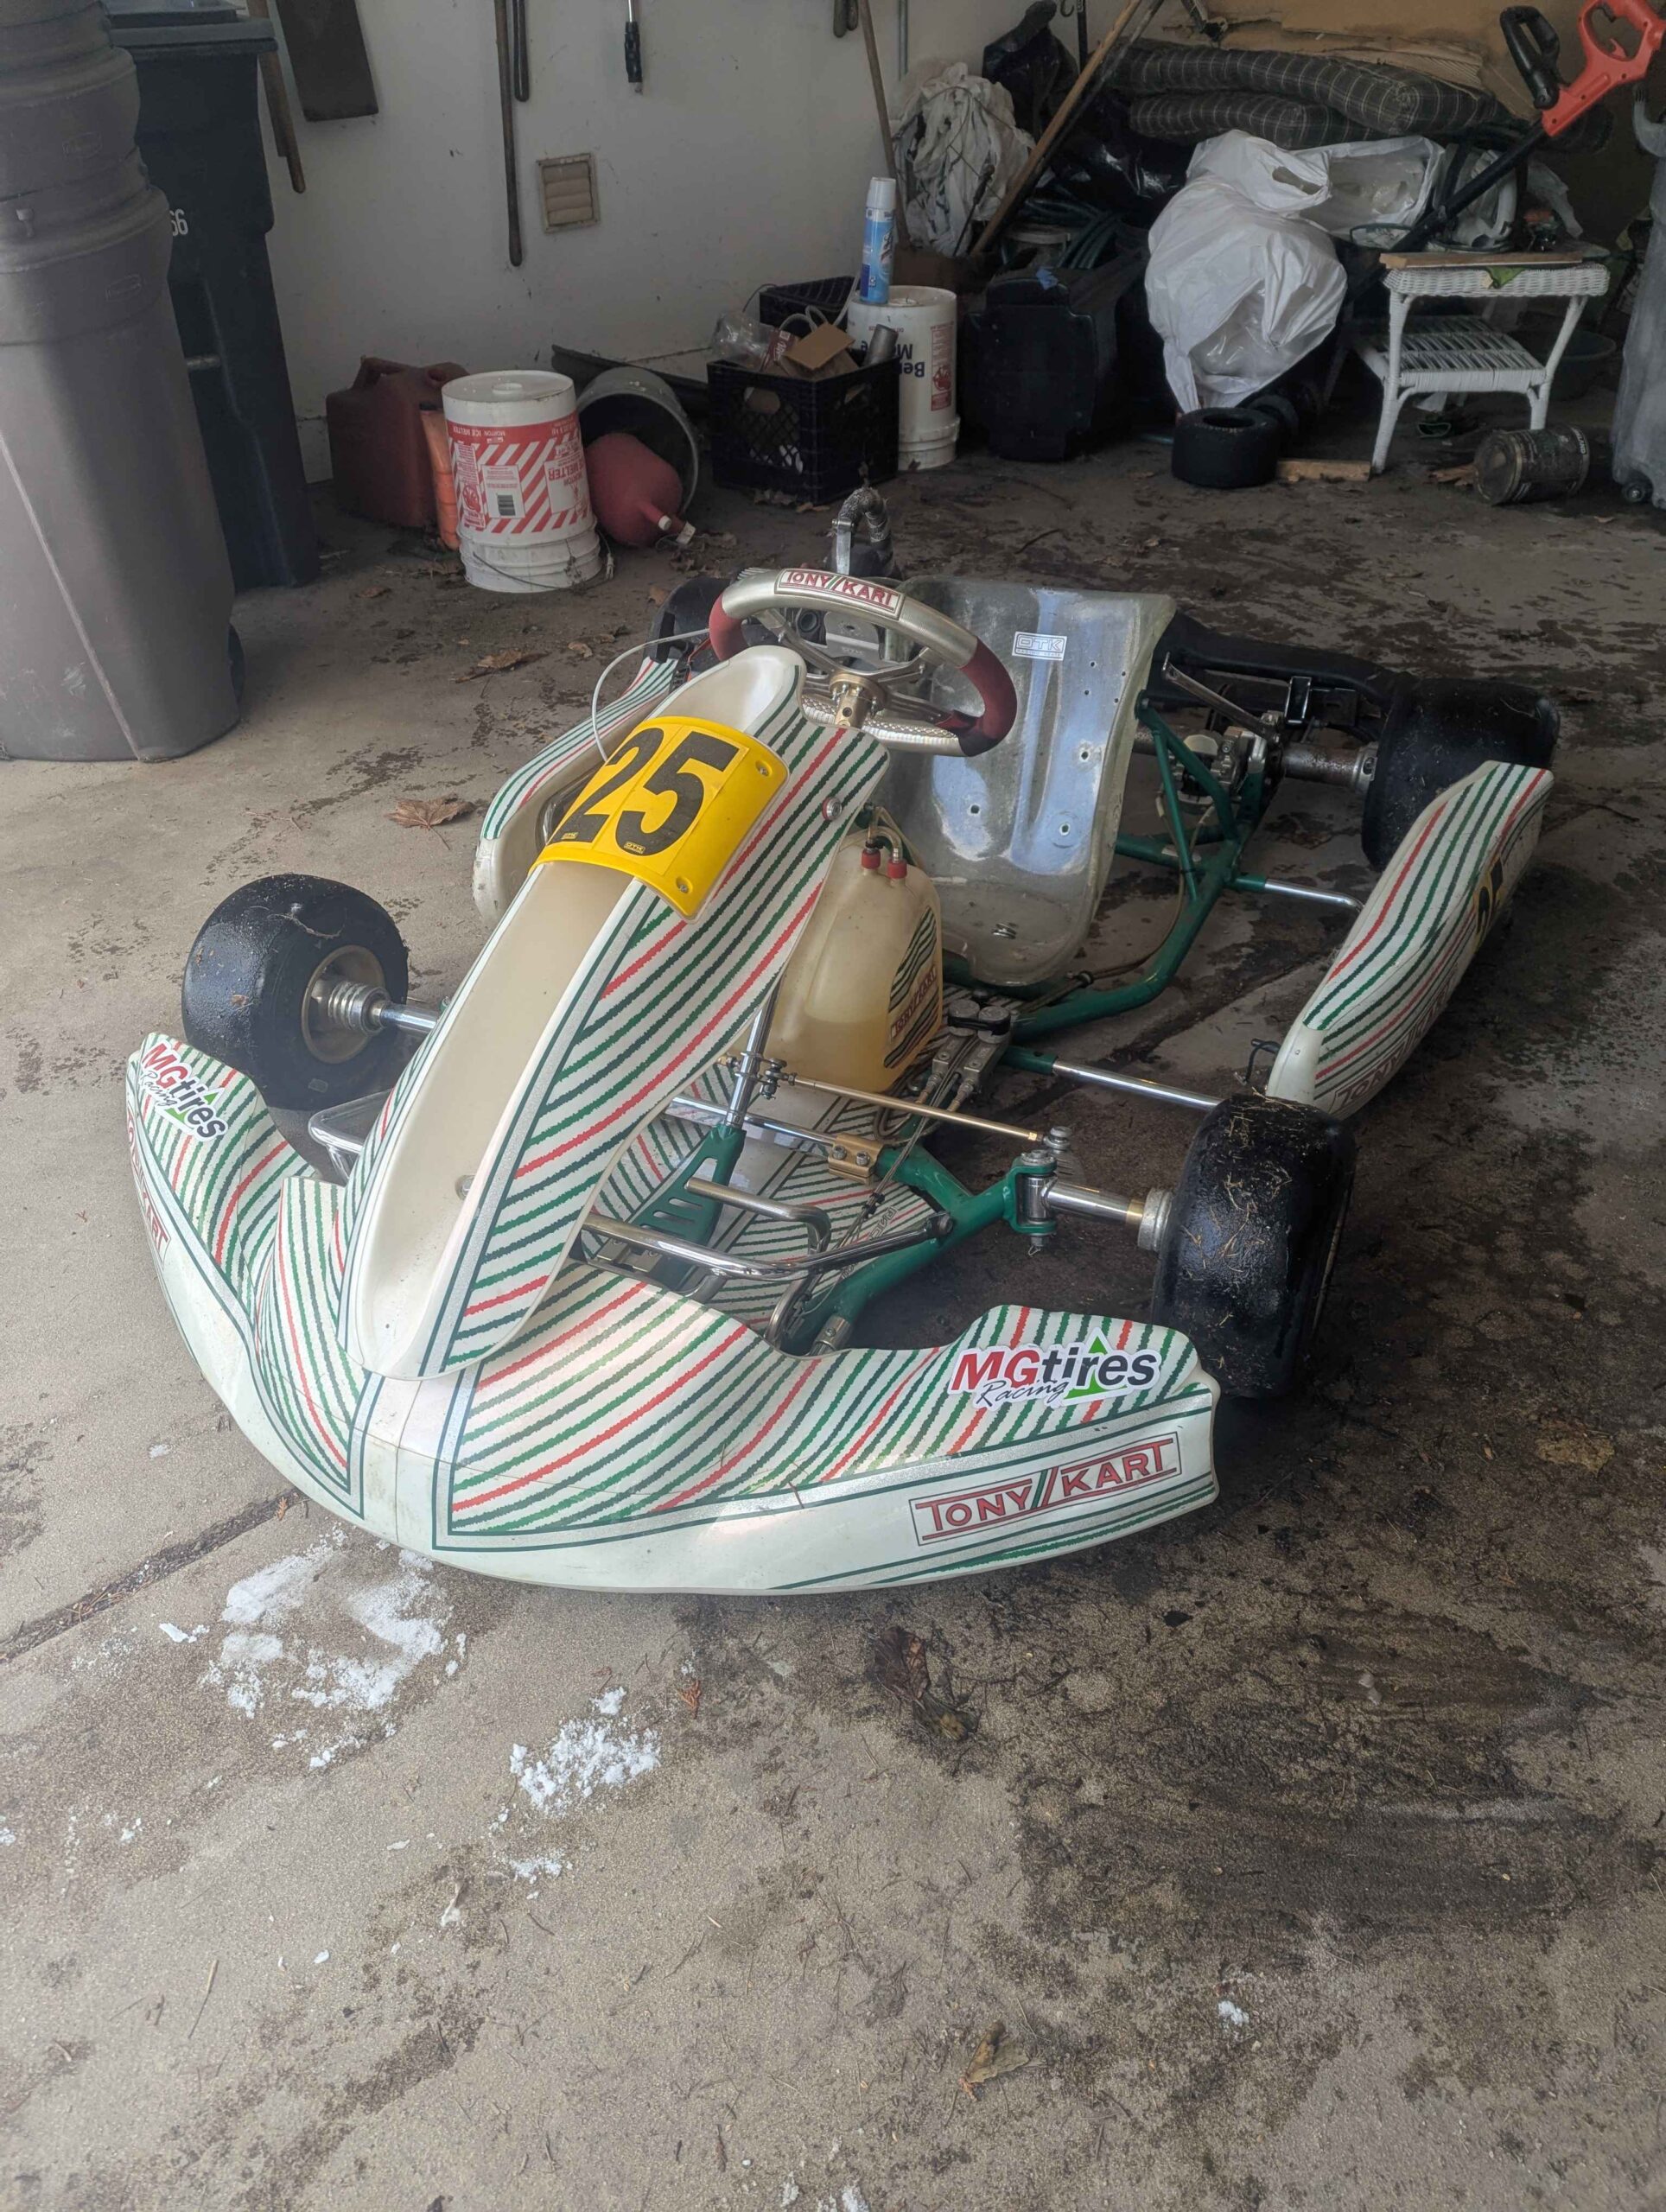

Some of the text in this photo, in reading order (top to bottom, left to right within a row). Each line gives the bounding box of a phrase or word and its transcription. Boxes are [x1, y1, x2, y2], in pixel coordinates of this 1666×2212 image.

[473, 429, 482, 437] ICE
[842, 581, 899, 607] KART
[1017, 635, 1063, 652] OTK
[547, 727, 740, 856] 25
[141, 1042, 226, 1138] MGtires
[951, 1345, 1157, 1389] MGtires
[976, 1379, 1070, 1407] Racing
[916, 1438, 1177, 1532] TONY KART
